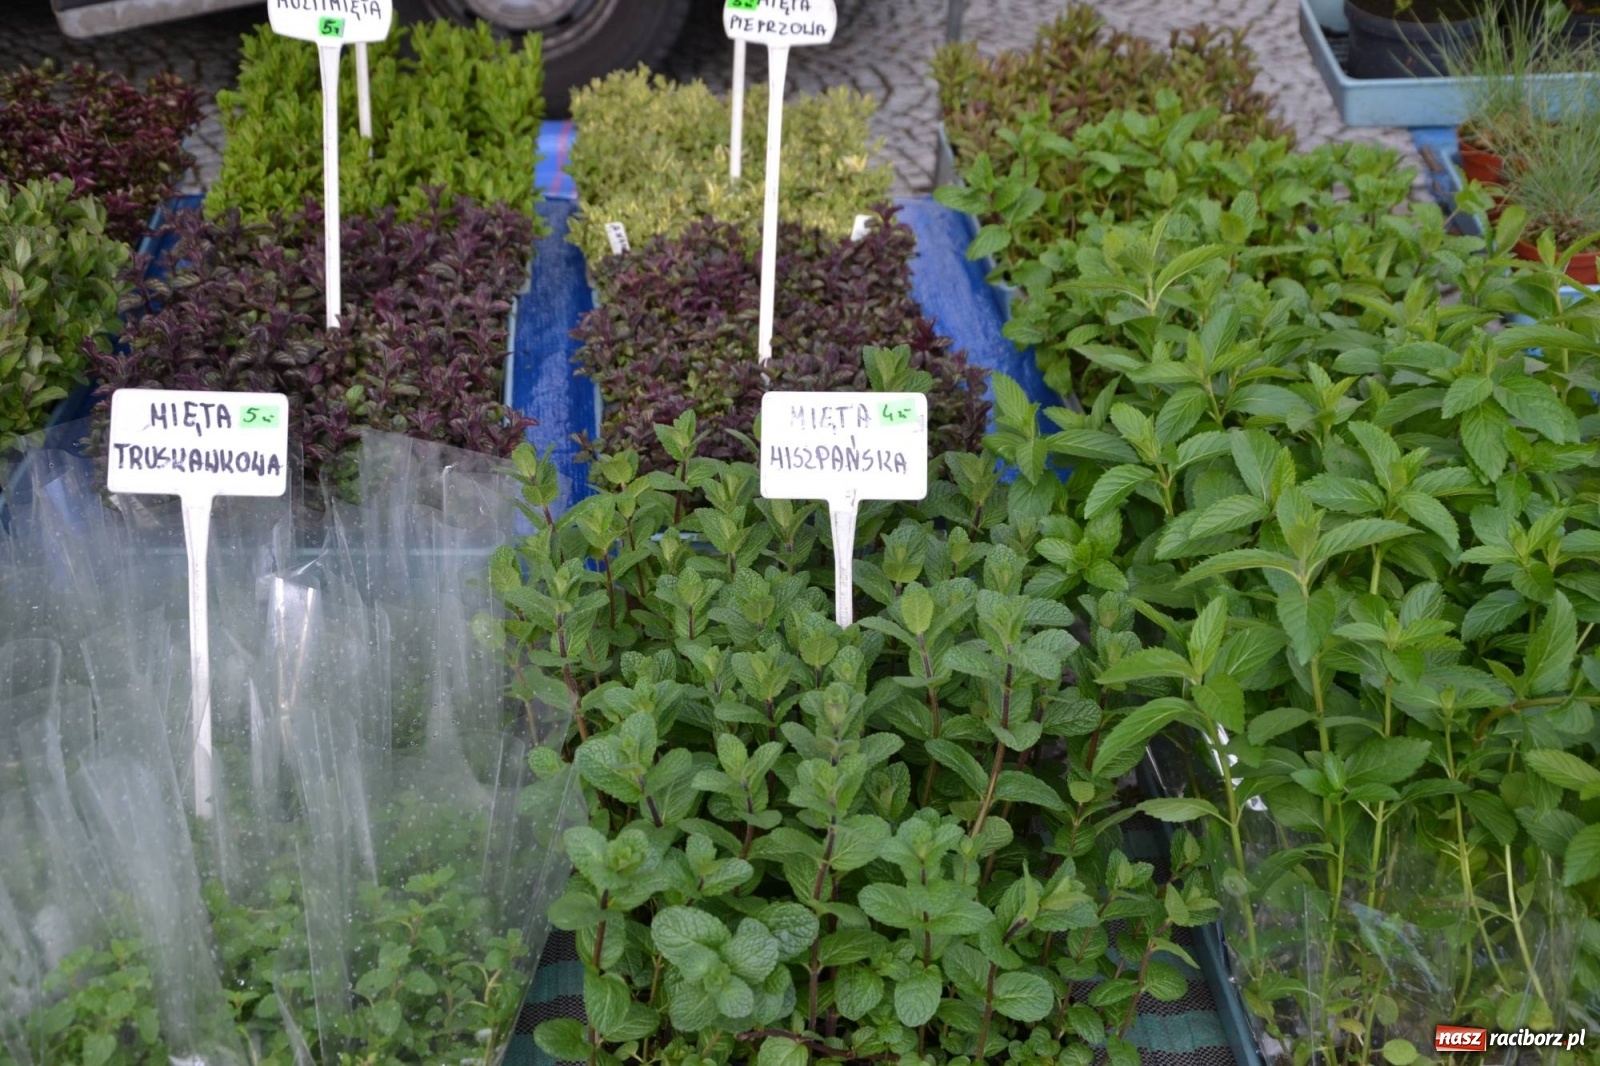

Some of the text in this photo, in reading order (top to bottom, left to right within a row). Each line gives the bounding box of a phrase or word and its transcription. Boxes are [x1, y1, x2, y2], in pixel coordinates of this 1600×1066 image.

[151, 401, 231, 437] MIĘTA
[791, 403, 871, 435] MIĘTA
[114, 443, 281, 476] TRUSKAWKOWA
[770, 435, 907, 474] HISZPAŃSKA
